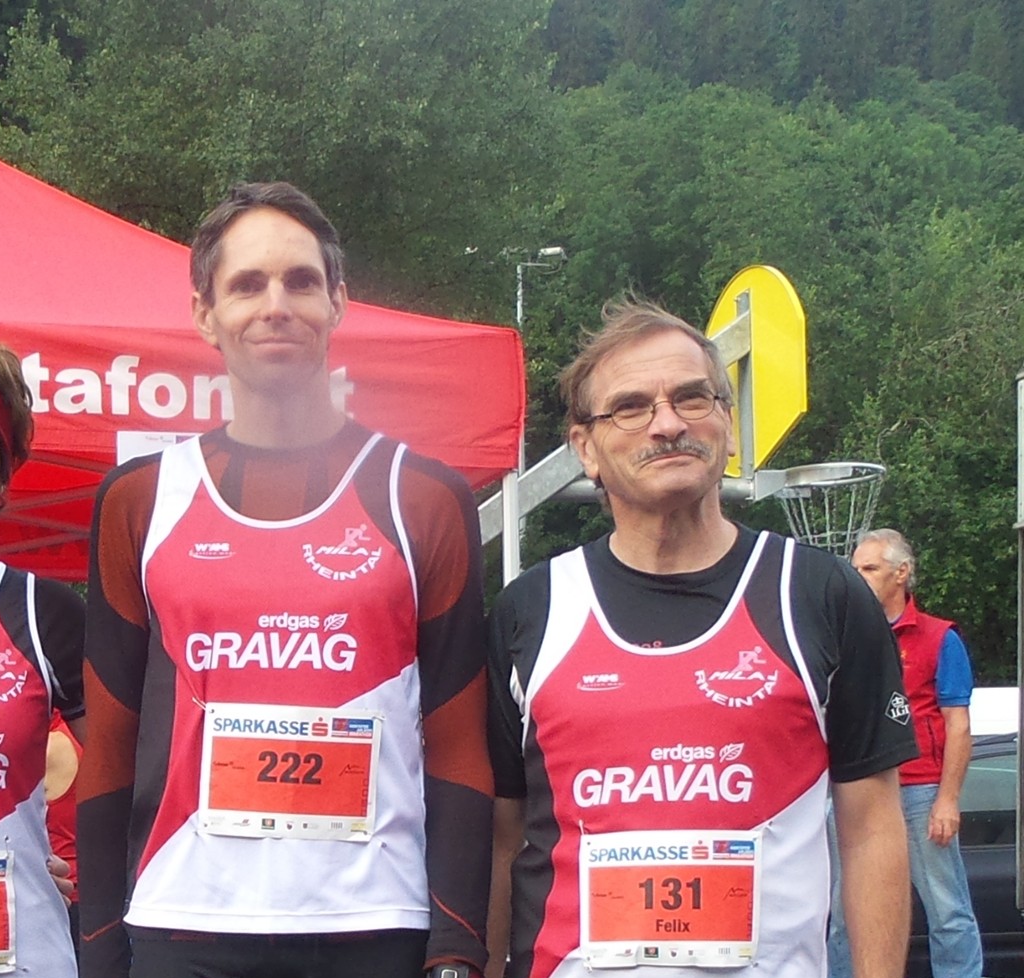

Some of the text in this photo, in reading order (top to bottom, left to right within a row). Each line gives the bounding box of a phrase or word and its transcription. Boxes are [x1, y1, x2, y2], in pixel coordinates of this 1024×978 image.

[302, 544, 382, 581] RHEINTAL
[258, 612, 320, 631] erdgas
[186, 632, 357, 672] GRAVAG
[694, 670, 779, 707] RHEINTAL
[213, 717, 309, 736] SPARKASSE
[257, 751, 323, 785] 222
[651, 743, 715, 763] erdgas
[573, 763, 753, 807] GRAVAG
[589, 846, 689, 862] SPARKASSE
[638, 877, 702, 910] 131
[655, 918, 690, 933] Felix
